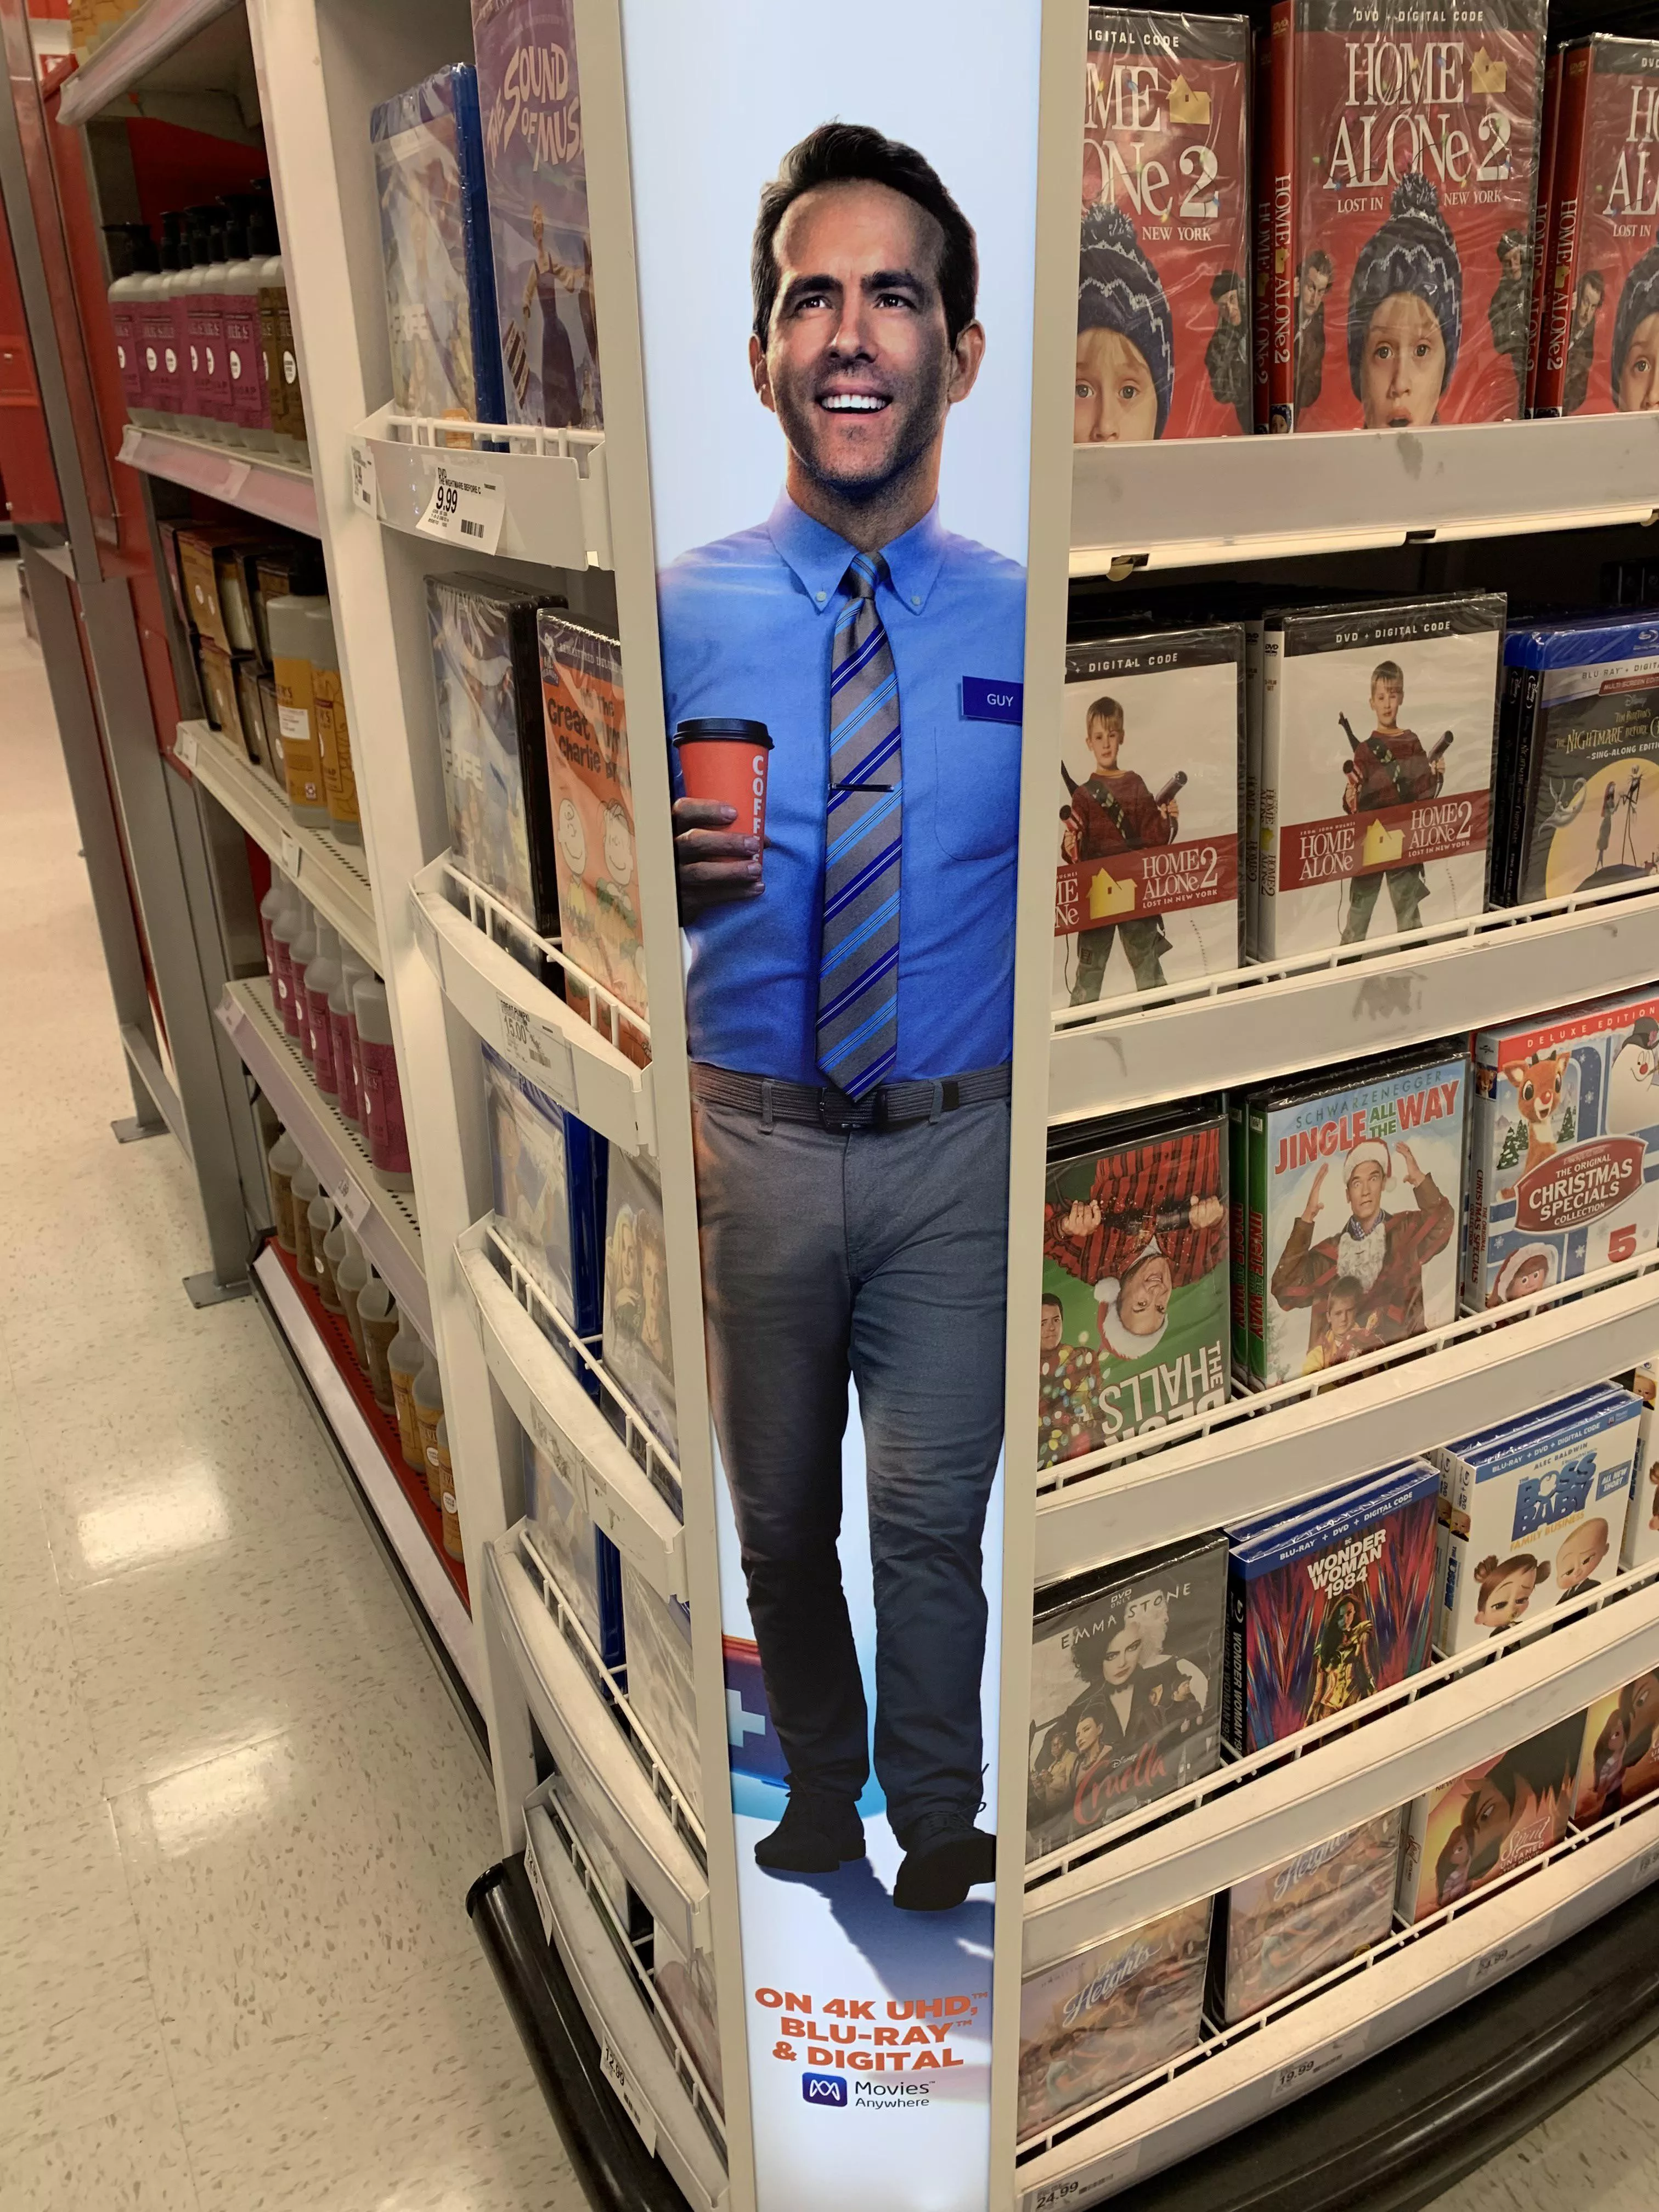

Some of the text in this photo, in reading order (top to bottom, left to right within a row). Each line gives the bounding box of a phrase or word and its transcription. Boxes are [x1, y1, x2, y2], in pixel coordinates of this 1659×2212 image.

[1356, 11, 1483, 21] DVD DIGITAL CODE
[1088, 30, 1179, 47] IGITAL CODE
[1345, 42, 1464, 106] HOME
[504, 42, 568, 154] SOUND
[1085, 63, 1160, 132] ME
[521, 95, 585, 172] OF MUS
[1323, 112, 1511, 189] ALONe 2
[1180, 146, 1218, 218] 2
[1275, 172, 1291, 247] HOME
[1338, 190, 1502, 213] LOST IN NEW YORK
[1142, 227, 1211, 241] NEW YORK
[1556, 198, 1578, 264] HOME
[1613, 225, 1651, 237] LOST IN
[1274, 348, 1290, 364] 2
[1548, 357, 1564, 371] 2
[436, 486, 458, 514] 9.99
[1336, 621, 1451, 643] DVD DIGITAL CODE
[1088, 653, 1178, 673] DIGITAL CODE
[987, 693, 1014, 708] GUY
[548, 698, 590, 741] Great
[558, 735, 601, 774] Charlie
[1565, 726, 1623, 754] NIGHTMARE
[1639, 742, 1659, 752] EDITI
[752, 755, 764, 862] COFF
[1410, 800, 1472, 840] HOME 2
[1300, 827, 1355, 860] HOME
[1408, 849, 1424, 857] LOST
[1409, 824, 1455, 850] ALONe
[1142, 849, 1200, 879] HOME
[1200, 847, 1218, 888] 2
[1267, 855, 1276, 886] HOME
[1299, 853, 1354, 881] ALONe
[1143, 872, 1200, 900] ALONe
[1143, 899, 1161, 909] LOST
[1176, 894, 1193, 902] NEW
[1195, 889, 1217, 898] YORK
[504, 1015, 527, 1045] 15.00
[1527, 1025, 1587, 1048] DELUXE
[1598, 1007, 1655, 1029] EDITION
[1296, 1070, 1442, 1129] SCHWARZENEGGER
[1369, 1102, 1396, 1124] ALL
[1274, 1079, 1460, 1175] JINGLE WAY
[1369, 1119, 1396, 1138] THE
[1556, 1167, 1572, 1178] THE
[1574, 1154, 1612, 1173] ORIGINAL
[1529, 1158, 1633, 1210] CHRISTMAS
[1540, 1181, 1620, 1221] SPECIALS
[1554, 1202, 1605, 1226] COLLECTION
[1471, 1169, 1483, 1284] CHRISTMAS SPECIALS
[1249, 1211, 1263, 1276] JINGLE
[1607, 1223, 1637, 1263] 5
[1098, 1340, 1223, 1435] THE HALLS
[1492, 1422, 1600, 1473] BLU-RAY DVD DIGITAL CODE
[1534, 1458, 1551, 1470] ALEC
[1554, 1442, 1588, 1461] BALDWIN
[1515, 1449, 1598, 1510] BOSS
[1601, 1467, 1628, 1485] ALL NEW
[1603, 1476, 1624, 1492] SHORT
[1279, 1539, 1316, 1561] BLU-RAY
[1333, 1523, 1349, 1536] DVD
[1364, 1503, 1392, 1521] DIGITAL
[1393, 1492, 1413, 1506] CODE
[1511, 1479, 1595, 1542] BABY
[1510, 1511, 1585, 1551] FAMILY BUSINESS
[1307, 1528, 1387, 1578] WONDER
[1311, 1544, 1382, 1590] WOMAN
[1111, 1589, 1132, 1603] DVD
[1324, 1566, 1368, 1599] 1984
[1061, 1583, 1191, 1650] EMMA STONE
[1111, 1595, 1132, 1609] ONLY
[1233, 1632, 1243, 1740] WONDER WOMAN
[1111, 1753, 1138, 1769] Disney
[1073, 1742, 1167, 1825] Cruella
[1063, 1943, 1163, 2028] Heights
[755, 1988, 812, 2014] ON
[822, 1999, 876, 2020] 4K
[772, 2041, 964, 2071] & DIGITAL
[1281, 2061, 1314, 2085] 19.99
[855, 2097, 929, 2110] Anywhere
[1036, 2181, 1079, 2210] 24.99
